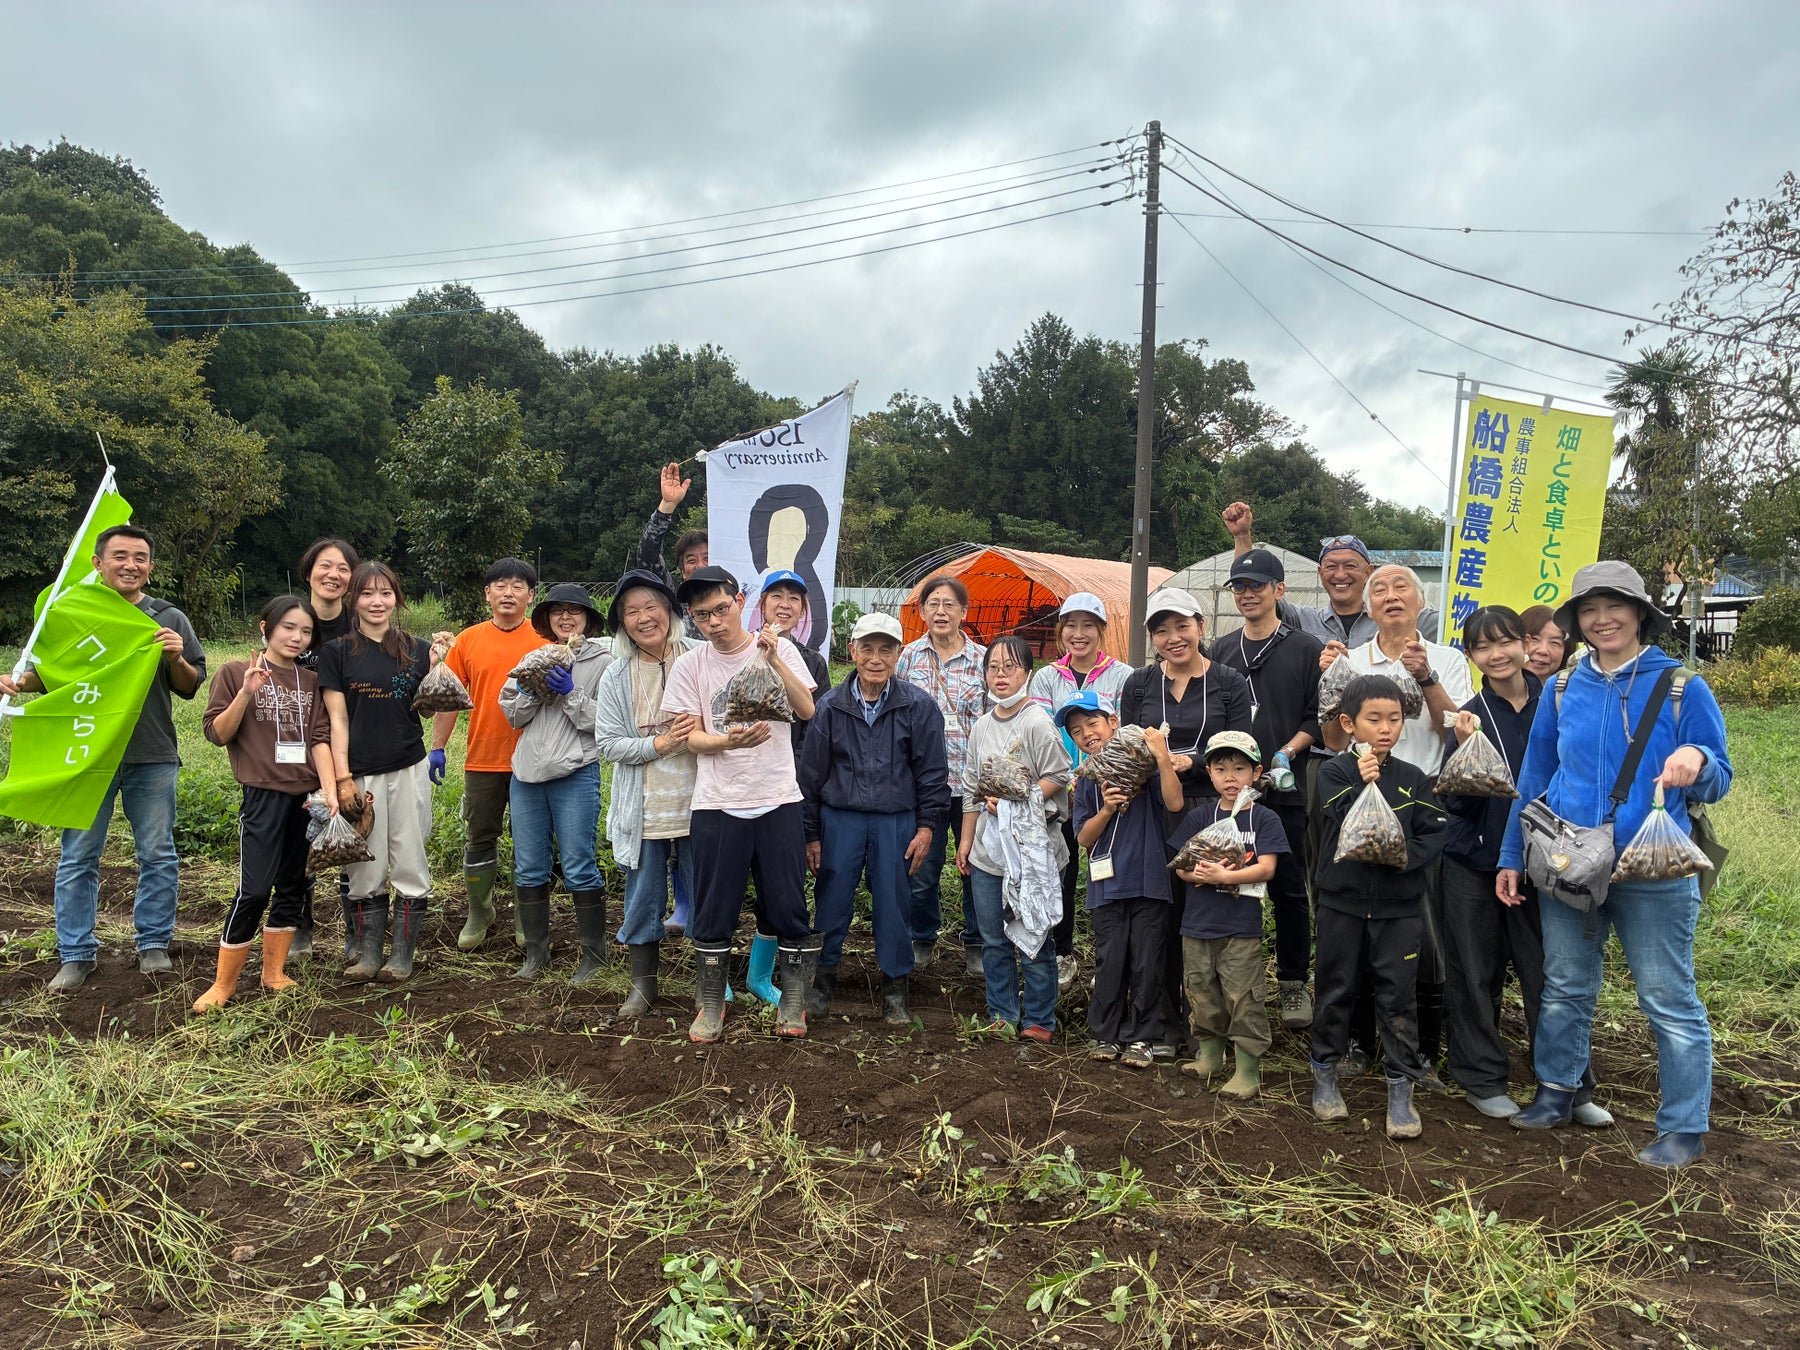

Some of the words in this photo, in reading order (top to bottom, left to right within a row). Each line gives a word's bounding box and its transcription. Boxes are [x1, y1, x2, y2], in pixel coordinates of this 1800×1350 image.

[1449, 408, 1510, 653] 船橋農産物
[1502, 417, 1536, 534] 農事組合法人
[1533, 424, 1583, 604] 畑と食卓といの
